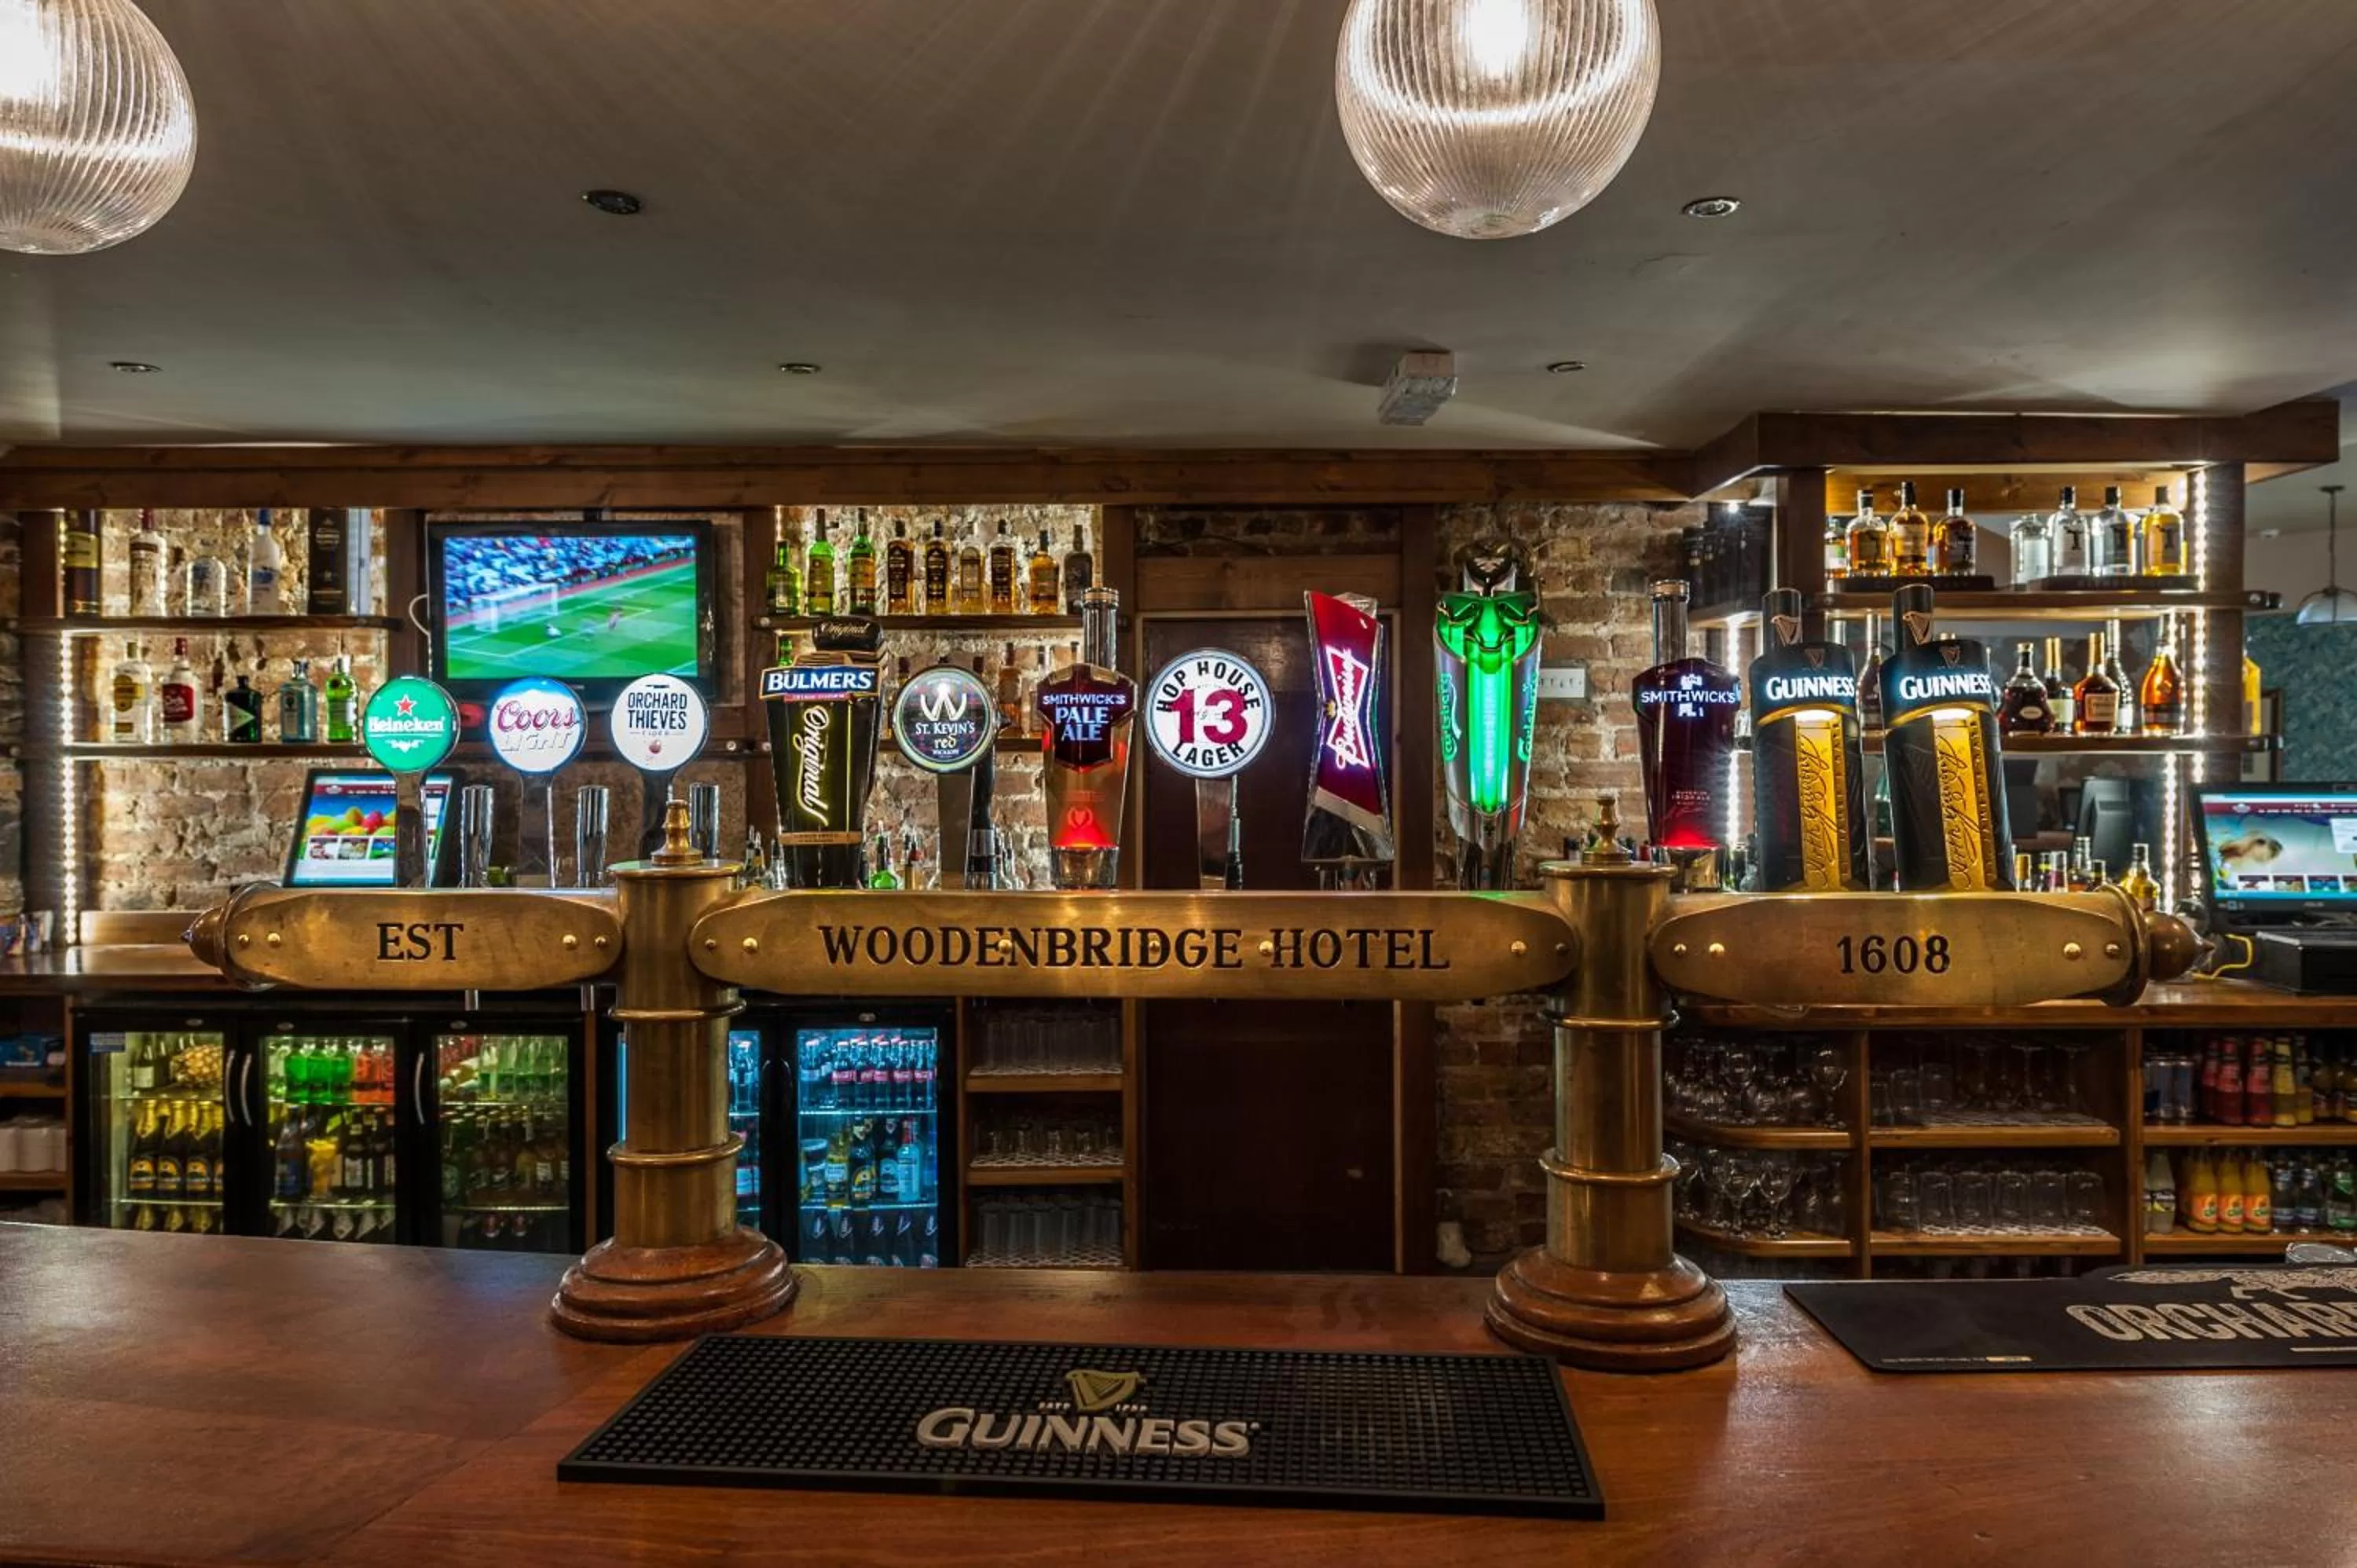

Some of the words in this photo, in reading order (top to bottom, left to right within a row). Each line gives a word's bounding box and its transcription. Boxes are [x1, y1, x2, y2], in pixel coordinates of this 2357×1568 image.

[768, 672, 872, 691] BULMERS
[1157, 670, 1186, 713] HOP
[1197, 661, 1260, 710] HOUSE
[1766, 676, 1855, 701] GUINNESS
[1900, 673, 1991, 700] GUINNESS
[628, 692, 687, 709] ORCHARD
[1043, 694, 1126, 705] SMITHWICK'S
[1640, 691, 1736, 704] SMITHWICK'S
[368, 716, 445, 732] Heineken
[497, 700, 577, 732] Coors
[628, 709, 687, 729] THIEVES
[933, 720, 975, 735] KEVIN'S
[1055, 706, 1109, 724] PALE
[1170, 689, 1248, 745] 13
[934, 733, 957, 749] red
[1061, 724, 1102, 742] ALE
[793, 705, 830, 826] Original
[1172, 742, 1244, 767] LAGER
[377, 922, 464, 961] EST
[817, 925, 1244, 969] WOODENBRIDGE
[1270, 928, 1451, 970] HOTEL
[1837, 934, 1951, 974] 1608
[916, 1407, 1251, 1456] GUINNESS
